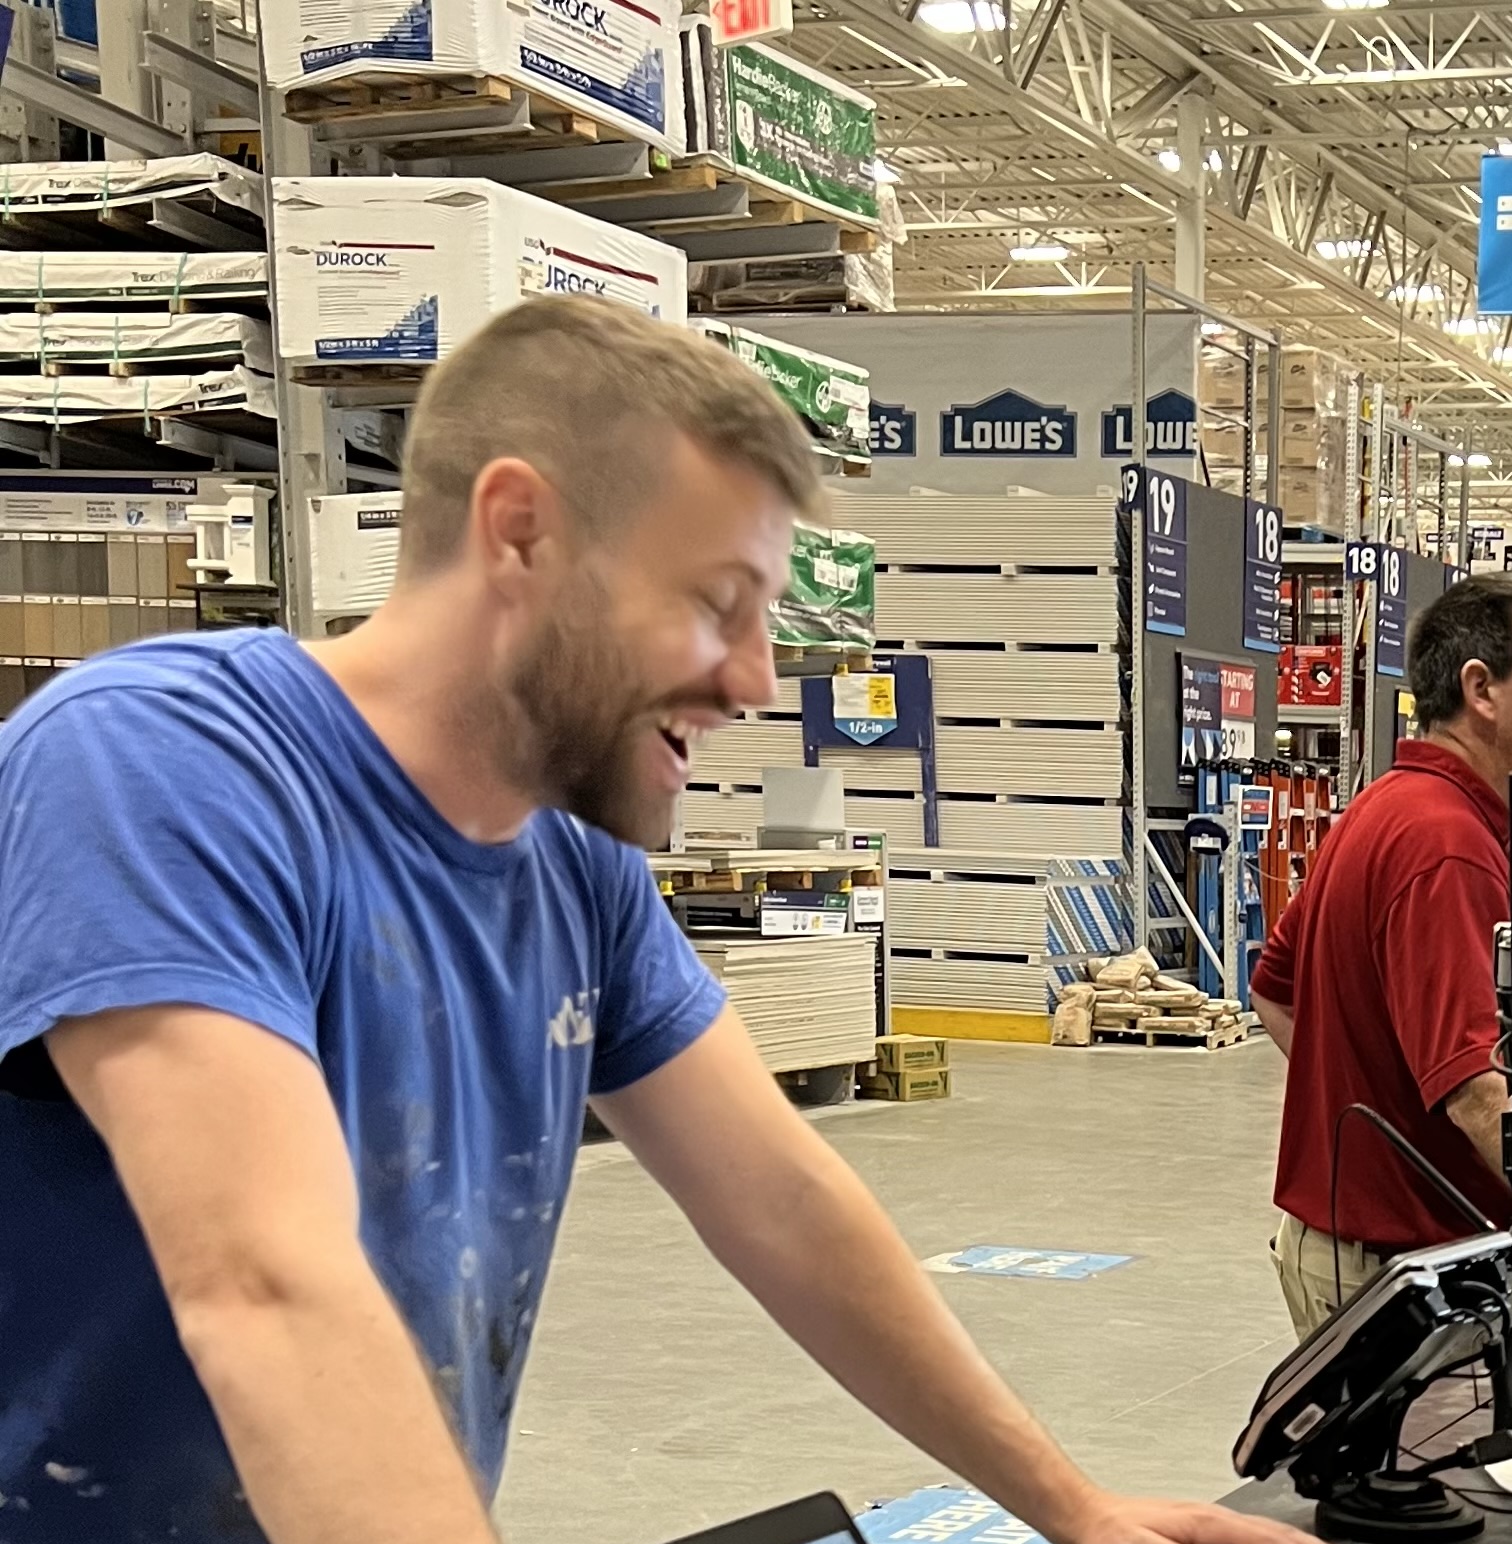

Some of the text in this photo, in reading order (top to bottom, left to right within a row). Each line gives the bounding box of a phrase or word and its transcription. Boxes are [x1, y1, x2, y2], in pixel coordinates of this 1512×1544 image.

[132, 271, 157, 282] Trex
[316, 252, 387, 267] DUROCK
[869, 416, 902, 450] E'S
[954, 416, 1063, 451] LOWE'S
[1122, 470, 1138, 503] 19
[1150, 476, 1175, 536] 19
[1255, 508, 1279, 562] 18
[1349, 547, 1377, 574] 18
[1382, 549, 1400, 597] 18
[1229, 691, 1241, 708] AT
[888, 1499, 1000, 1542] HERE
